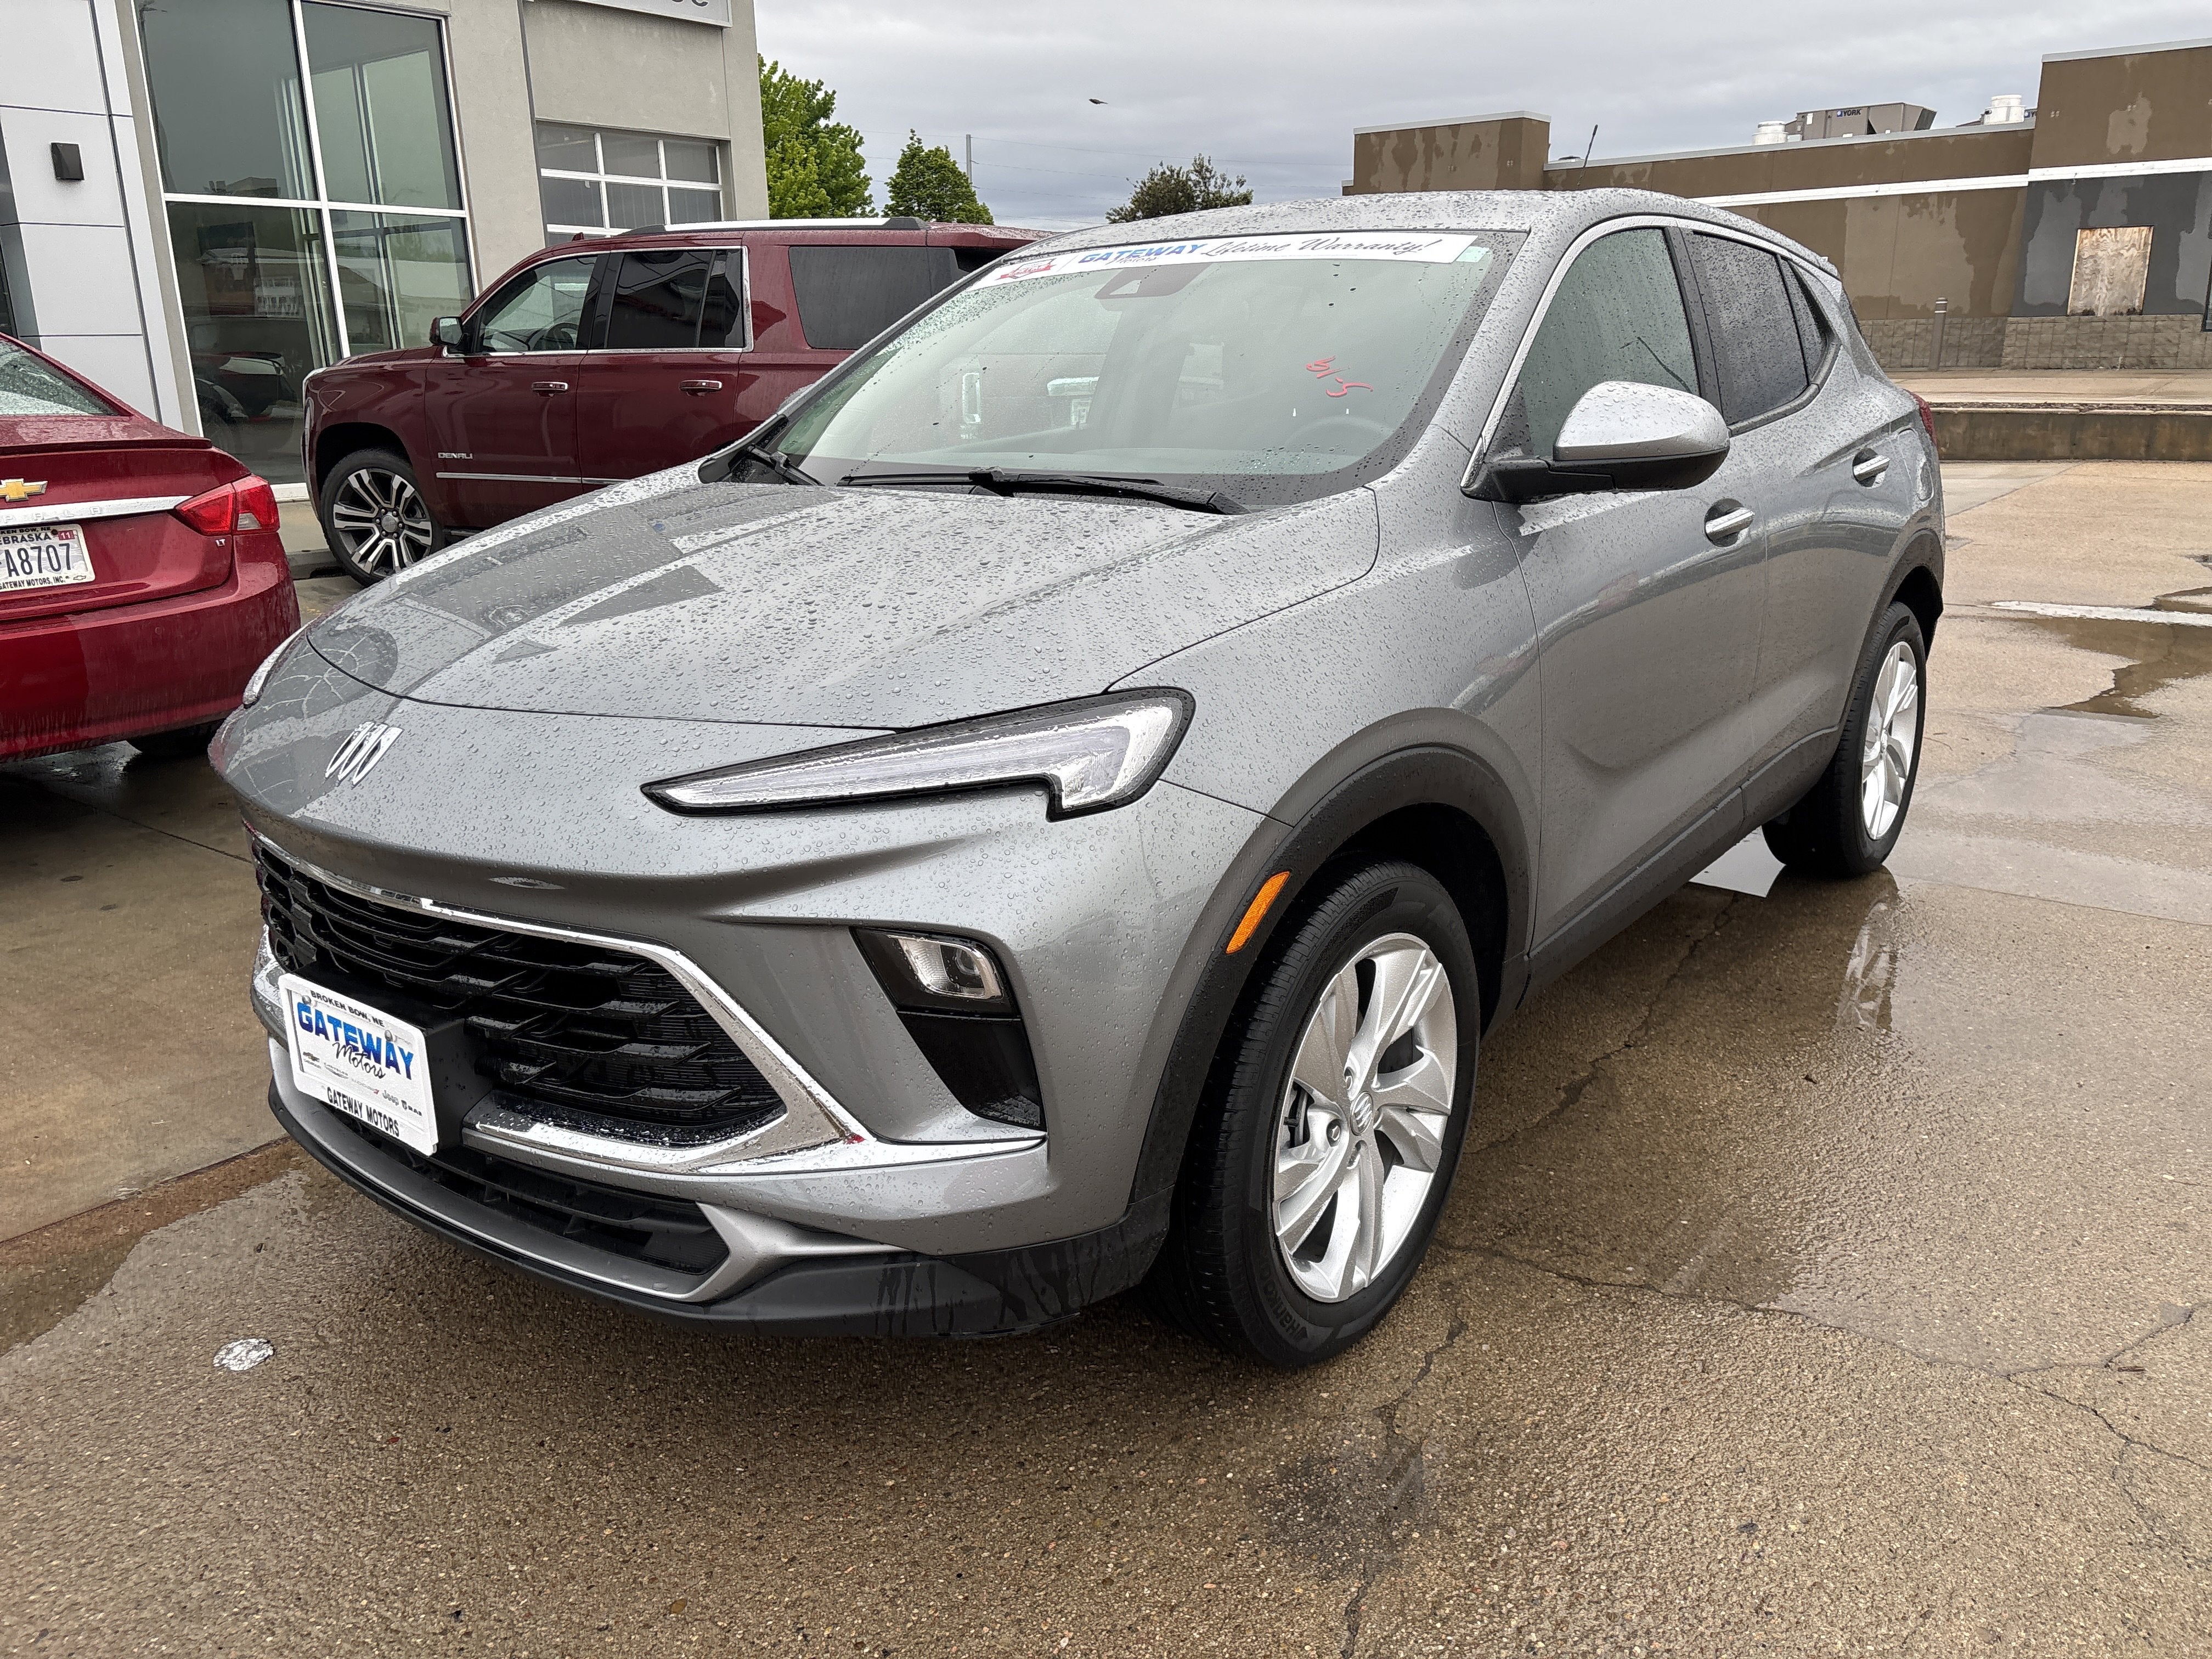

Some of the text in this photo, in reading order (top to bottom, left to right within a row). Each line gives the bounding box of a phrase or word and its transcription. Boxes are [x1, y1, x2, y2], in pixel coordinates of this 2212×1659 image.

[1078, 238, 1442, 263] GATEWAY Lifetime Warranty!
[215, 539, 225, 547] LT
[311, 990, 385, 1028] BROKEN BOW, NE
[297, 1002, 414, 1080] GATEWAY
[332, 1042, 386, 1079] Motors
[327, 1086, 400, 1137] GATEWAY MOTORS
